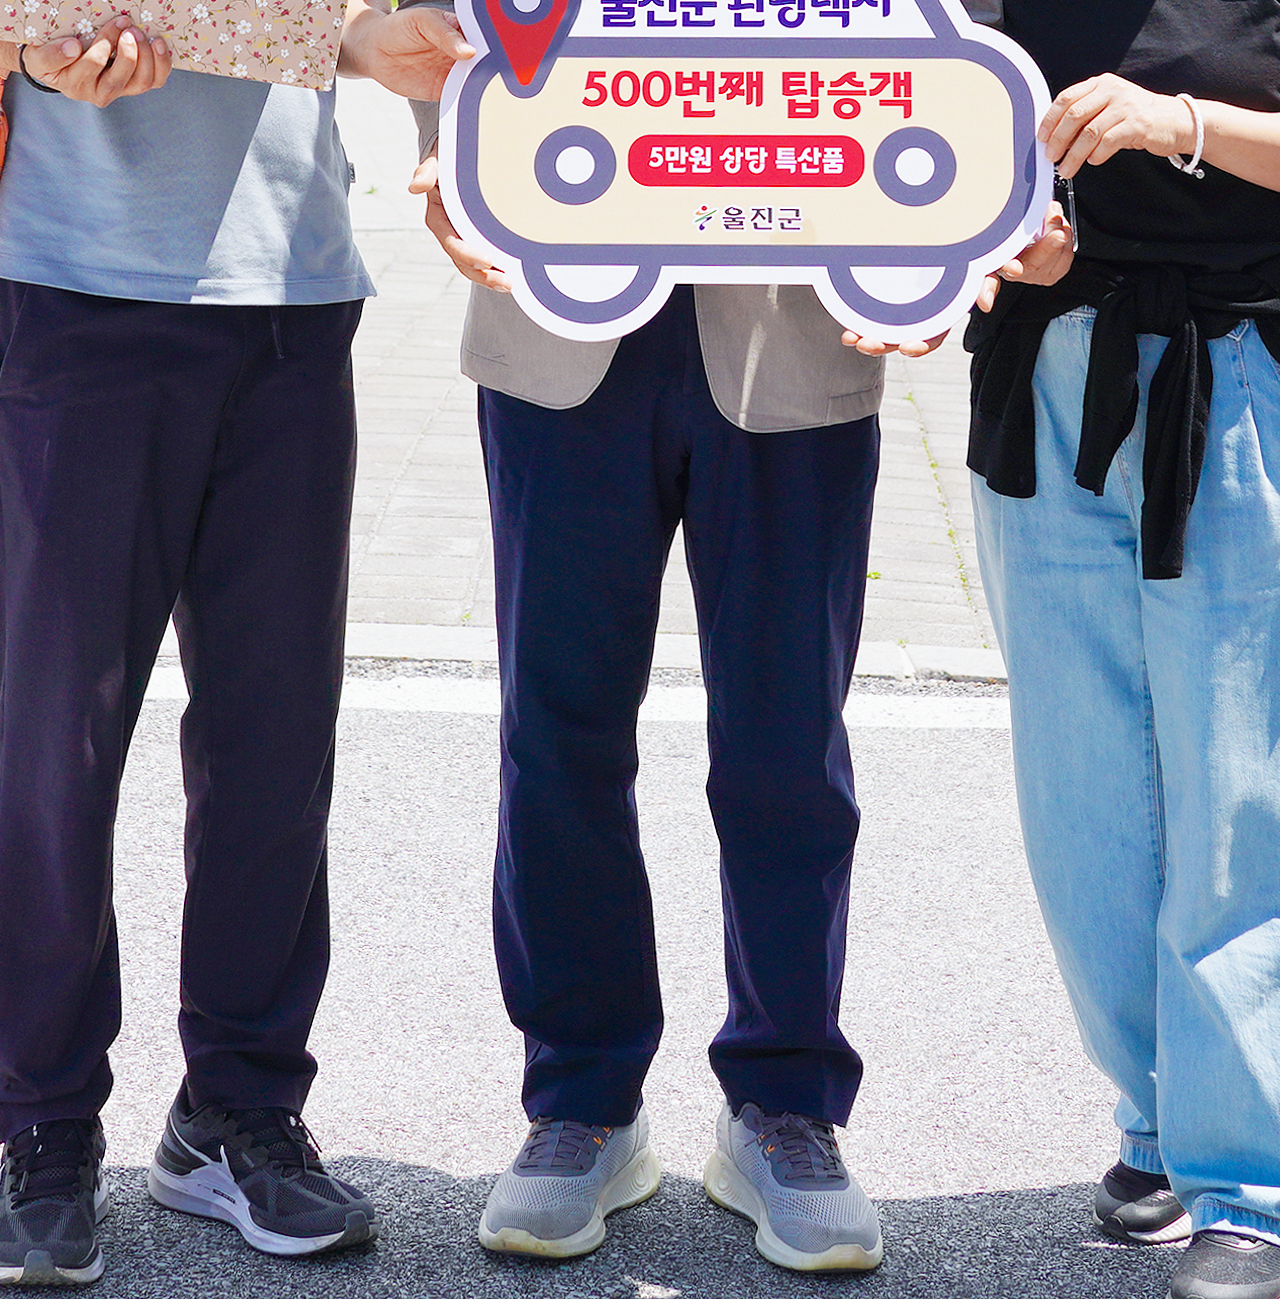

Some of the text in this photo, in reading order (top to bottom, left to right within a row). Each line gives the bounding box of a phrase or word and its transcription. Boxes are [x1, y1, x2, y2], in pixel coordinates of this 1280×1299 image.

[581, 70, 913, 119] 500번째 탑승객
[648, 146, 845, 174] 5만원 상당 특산품
[722, 206, 802, 230] 울진군
